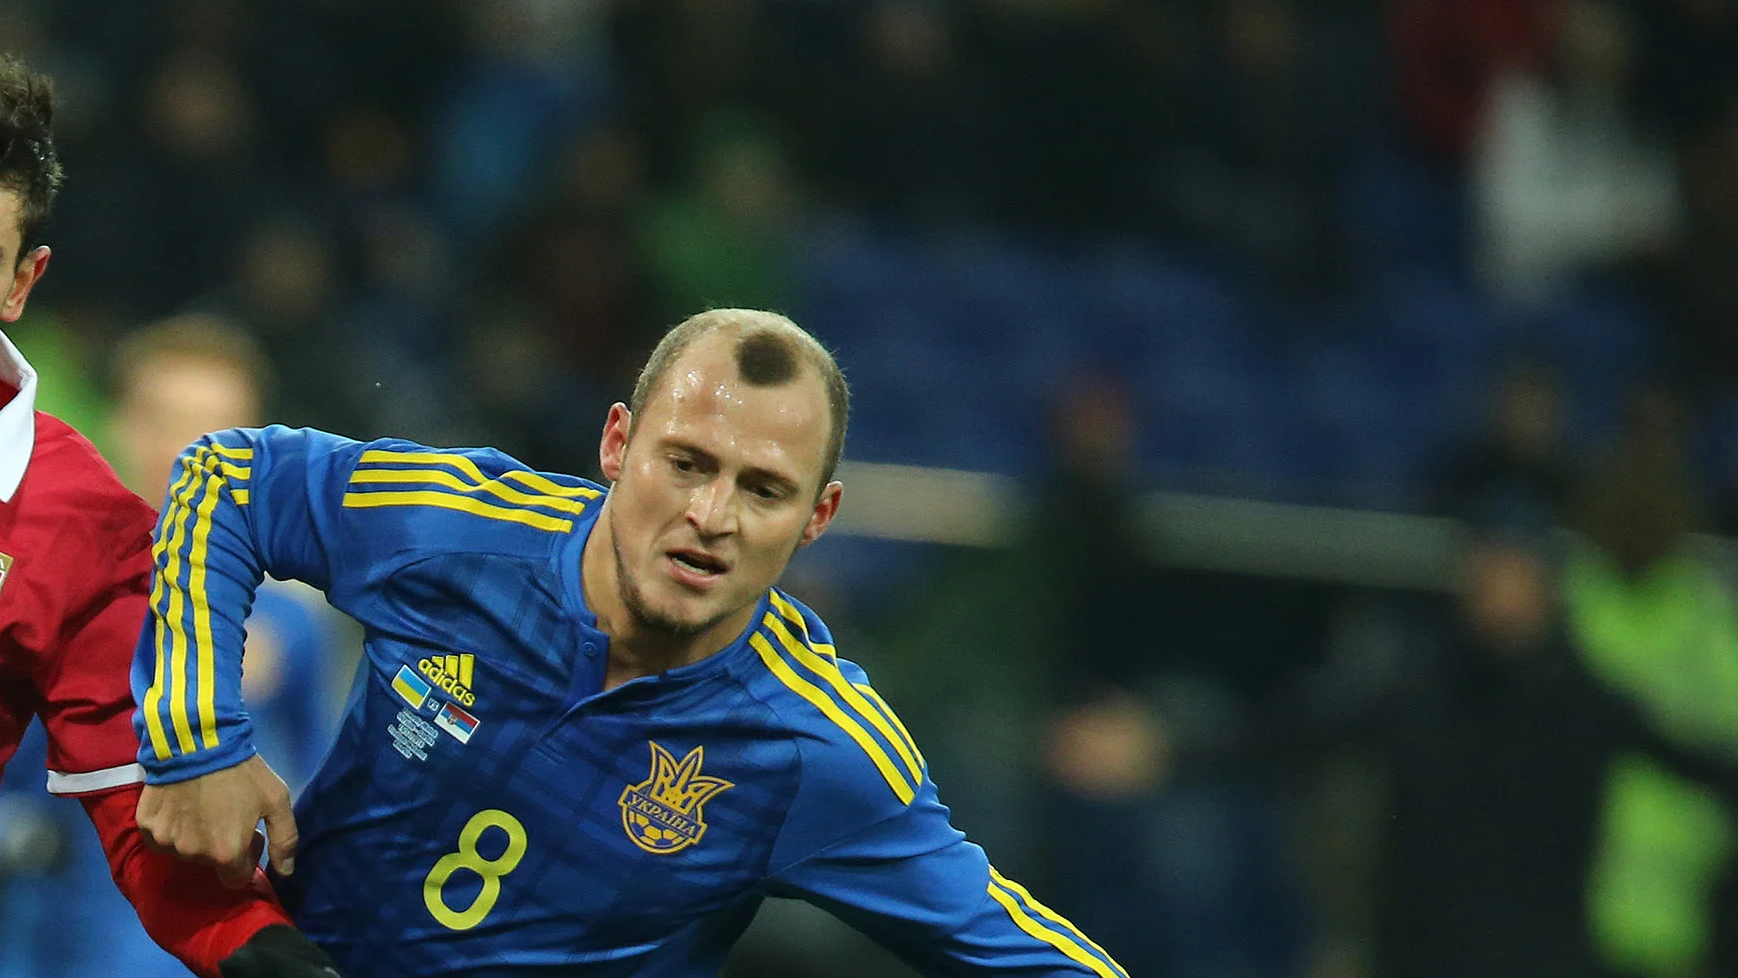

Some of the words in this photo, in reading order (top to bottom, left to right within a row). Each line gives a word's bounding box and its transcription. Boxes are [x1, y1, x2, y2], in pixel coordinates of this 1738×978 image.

[418, 659, 475, 707] adidas
[627, 793, 696, 836] УКРАЇНА
[423, 809, 528, 931] 8
